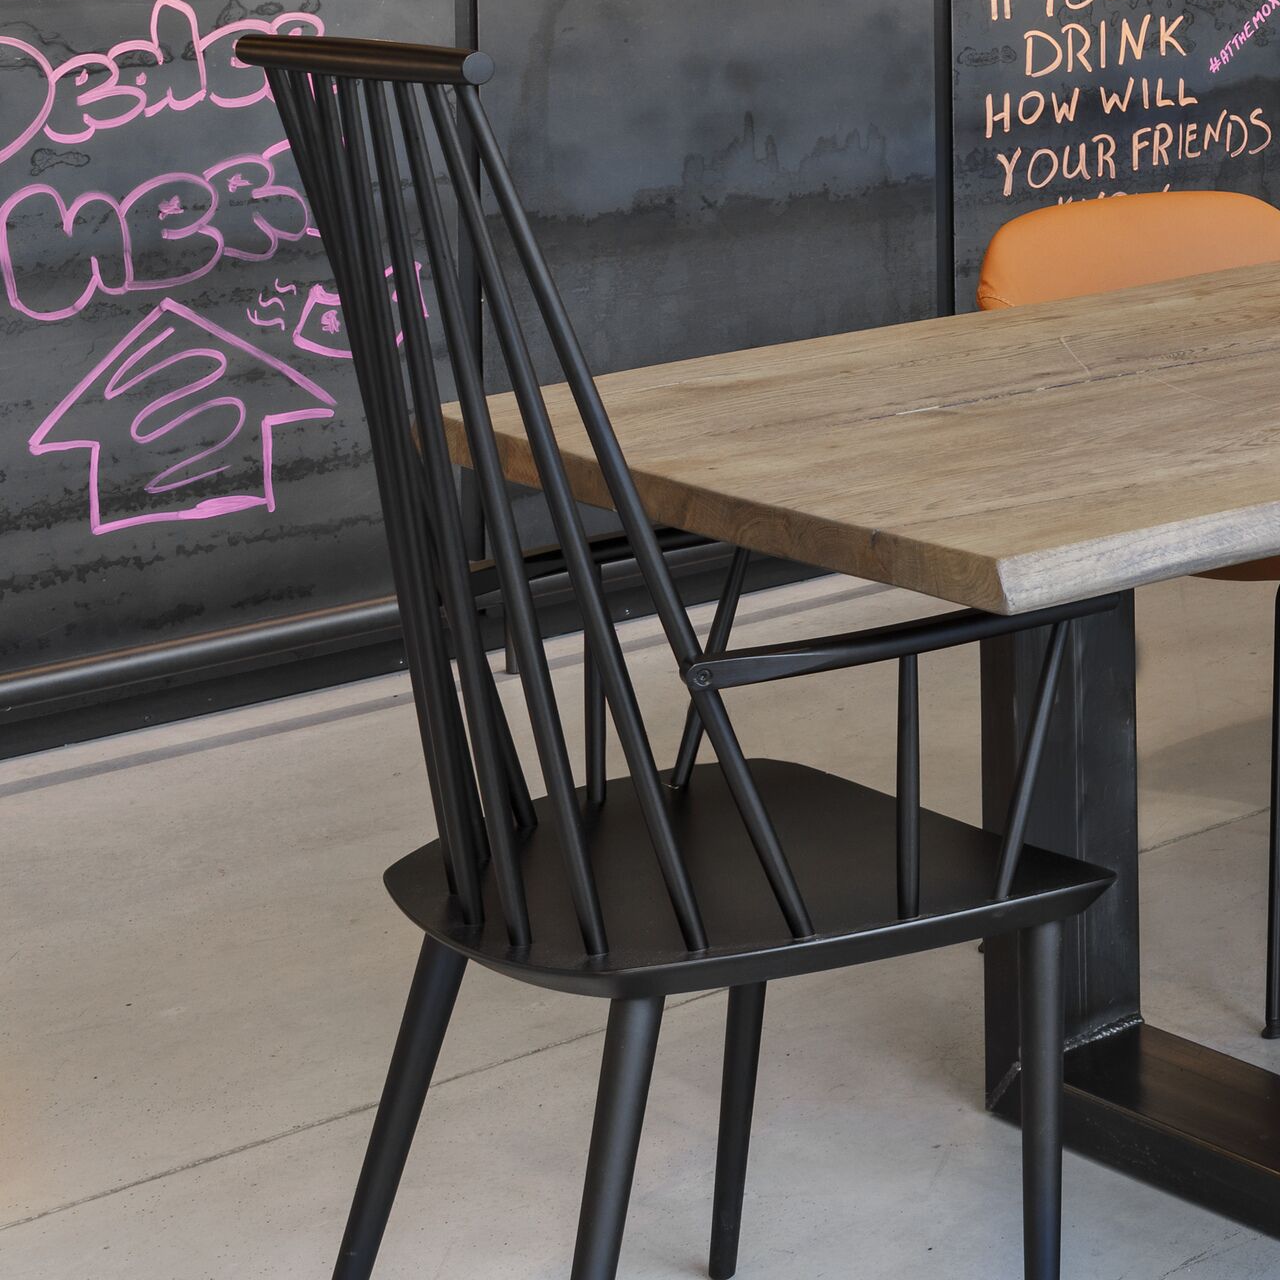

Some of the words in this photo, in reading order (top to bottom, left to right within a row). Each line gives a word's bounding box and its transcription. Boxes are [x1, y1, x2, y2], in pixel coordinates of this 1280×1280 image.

[1023, 13, 1188, 78] DRINK
[985, 87, 1080, 139] HOW
[1099, 76, 1199, 115] WILL
[996, 133, 1117, 197] YOUR
[1131, 107, 1273, 171] FRIENDS
